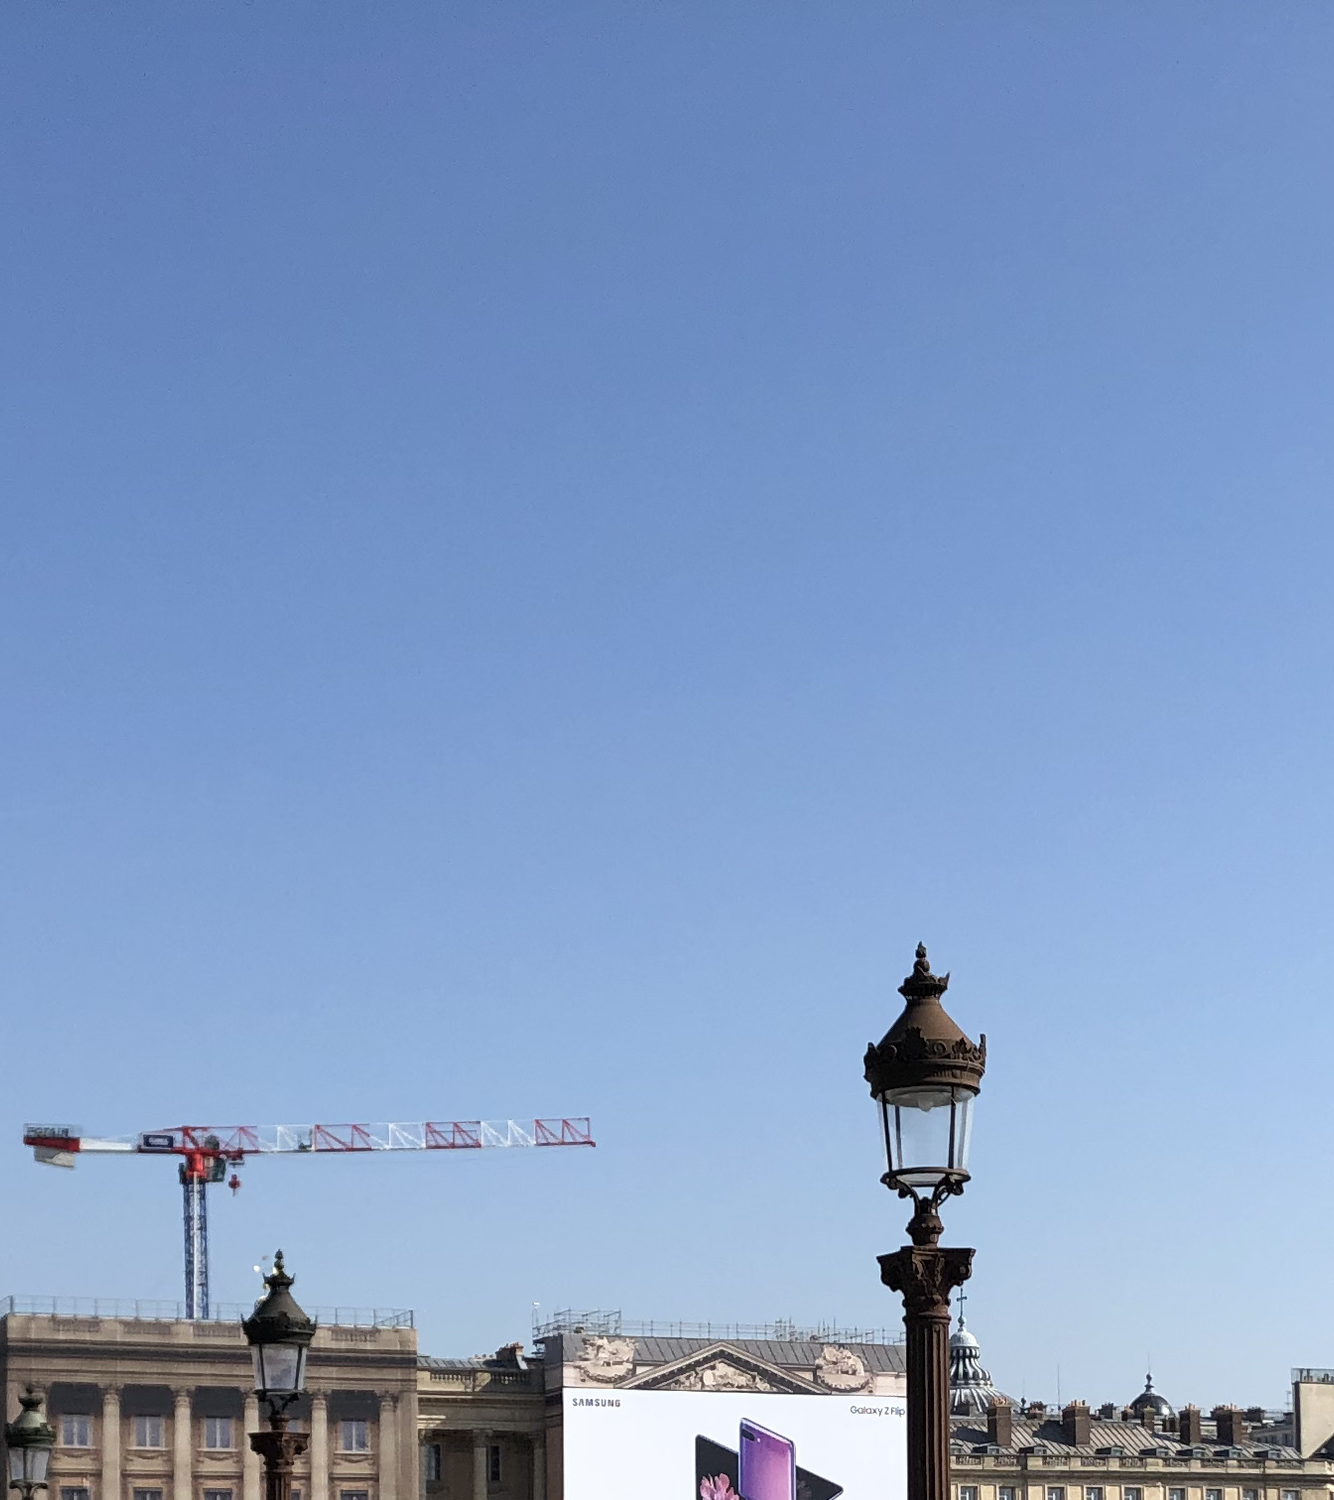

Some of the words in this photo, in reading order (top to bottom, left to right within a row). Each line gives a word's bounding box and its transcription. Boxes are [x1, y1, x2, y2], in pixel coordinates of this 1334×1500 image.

[572, 1398, 621, 1408] SAMSUNG
[850, 1405, 883, 1417] Galaxy
[884, 1406, 890, 1415] Z
[890, 1406, 906, 1418] Flip
